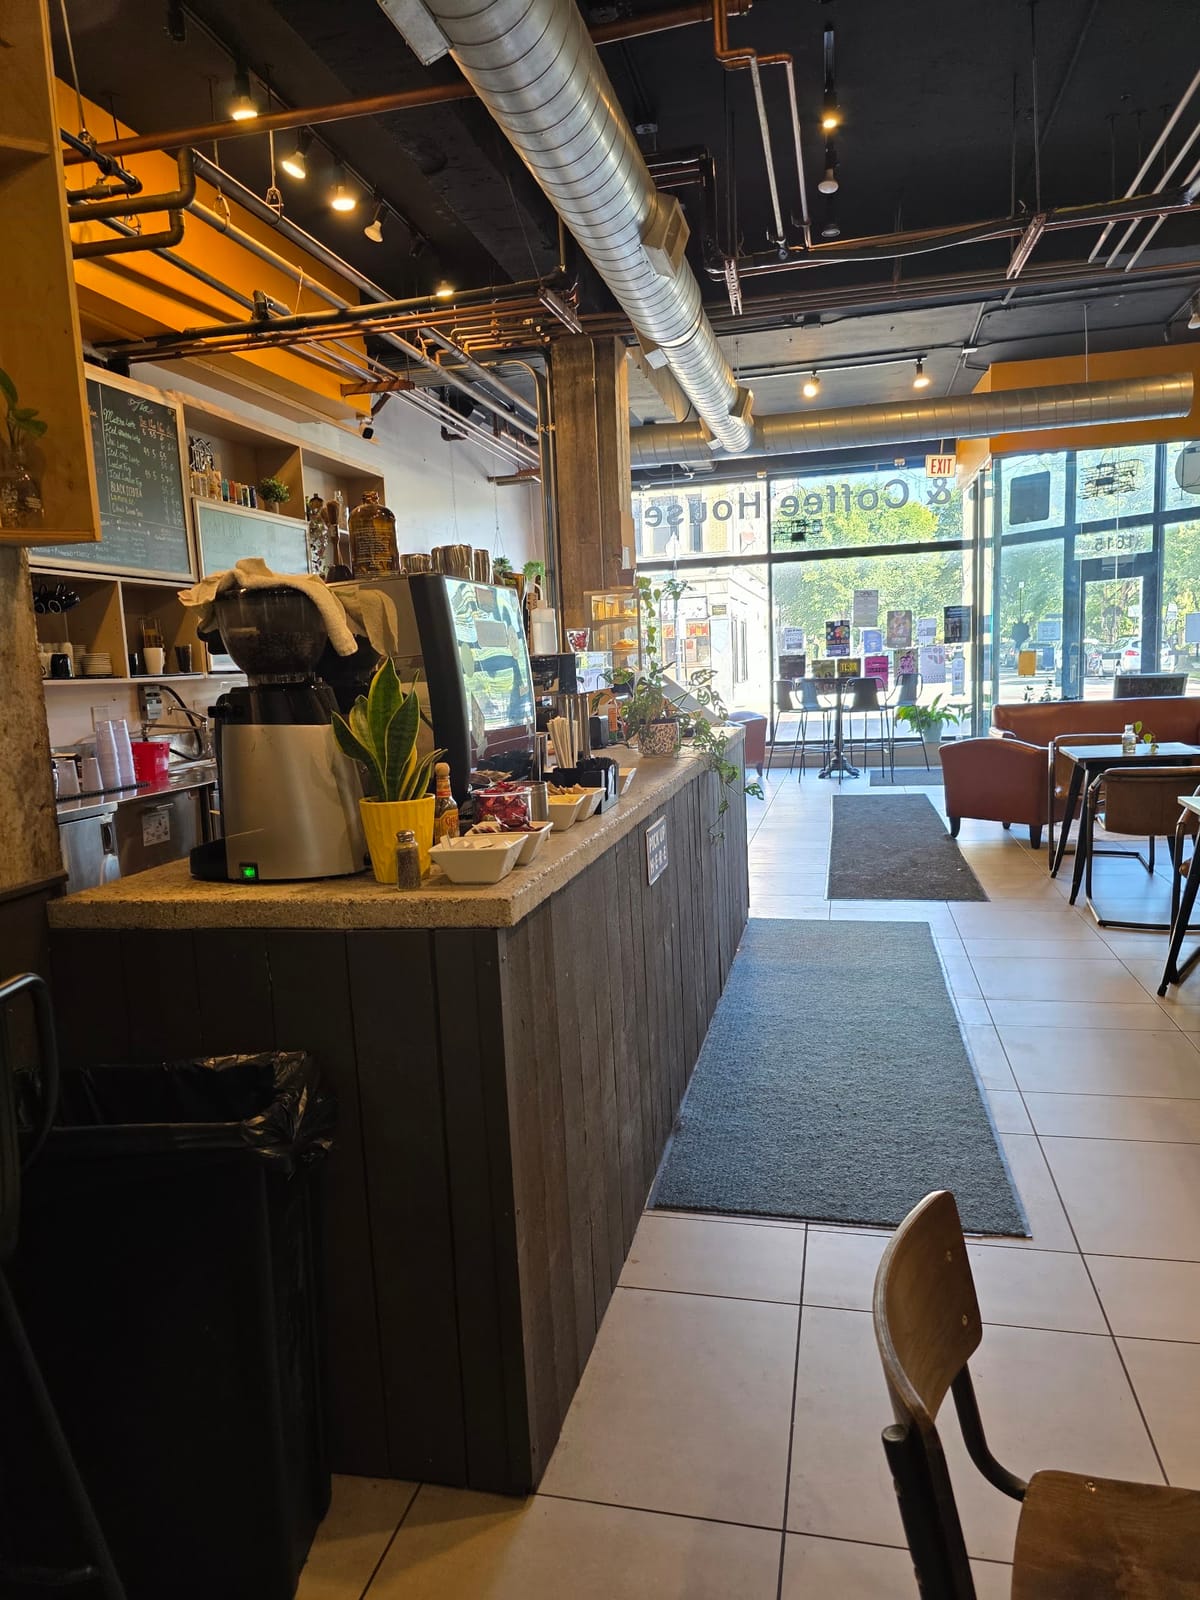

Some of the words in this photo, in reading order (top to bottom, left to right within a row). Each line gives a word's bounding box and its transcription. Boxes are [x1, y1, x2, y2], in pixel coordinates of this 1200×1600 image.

[930, 459, 951, 475] EXIT
[649, 833, 659, 854] PICK
[659, 824, 665, 843] UP
